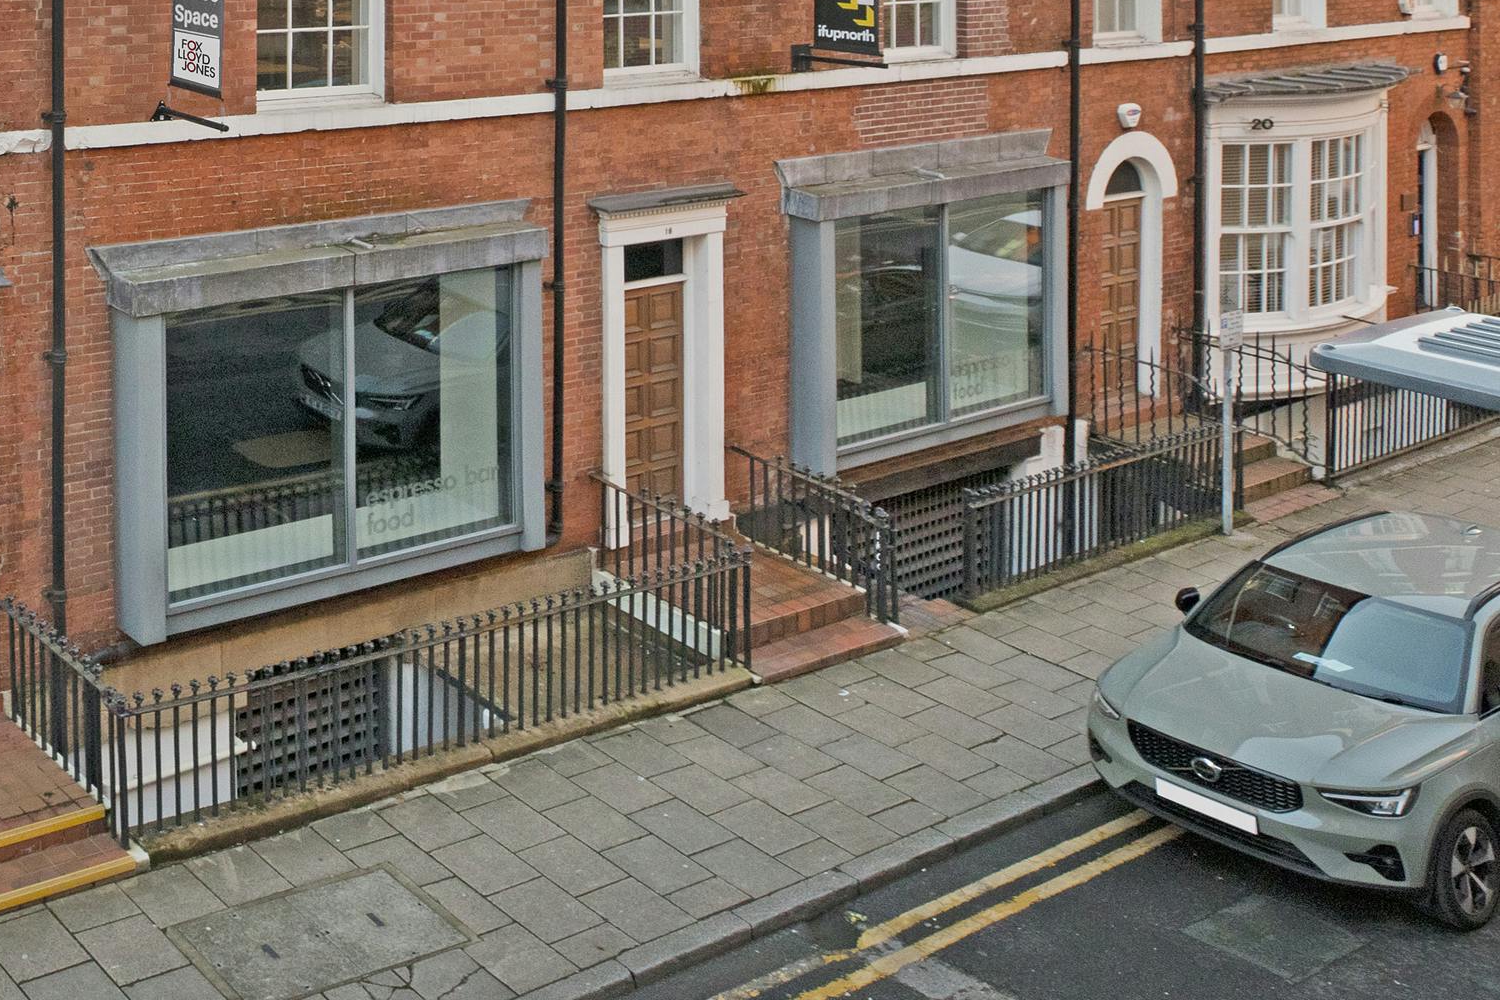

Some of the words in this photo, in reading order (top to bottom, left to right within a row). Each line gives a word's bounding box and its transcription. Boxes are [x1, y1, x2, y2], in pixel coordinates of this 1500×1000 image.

[174, 3, 219, 29] Space
[818, 24, 875, 42] ifupnorth
[181, 38, 203, 53] FOX
[177, 48, 211, 65] LLOYD
[181, 61, 216, 79] JONES
[1252, 118, 1274, 130] 20
[366, 475, 457, 509] espresso
[366, 503, 415, 536] food
